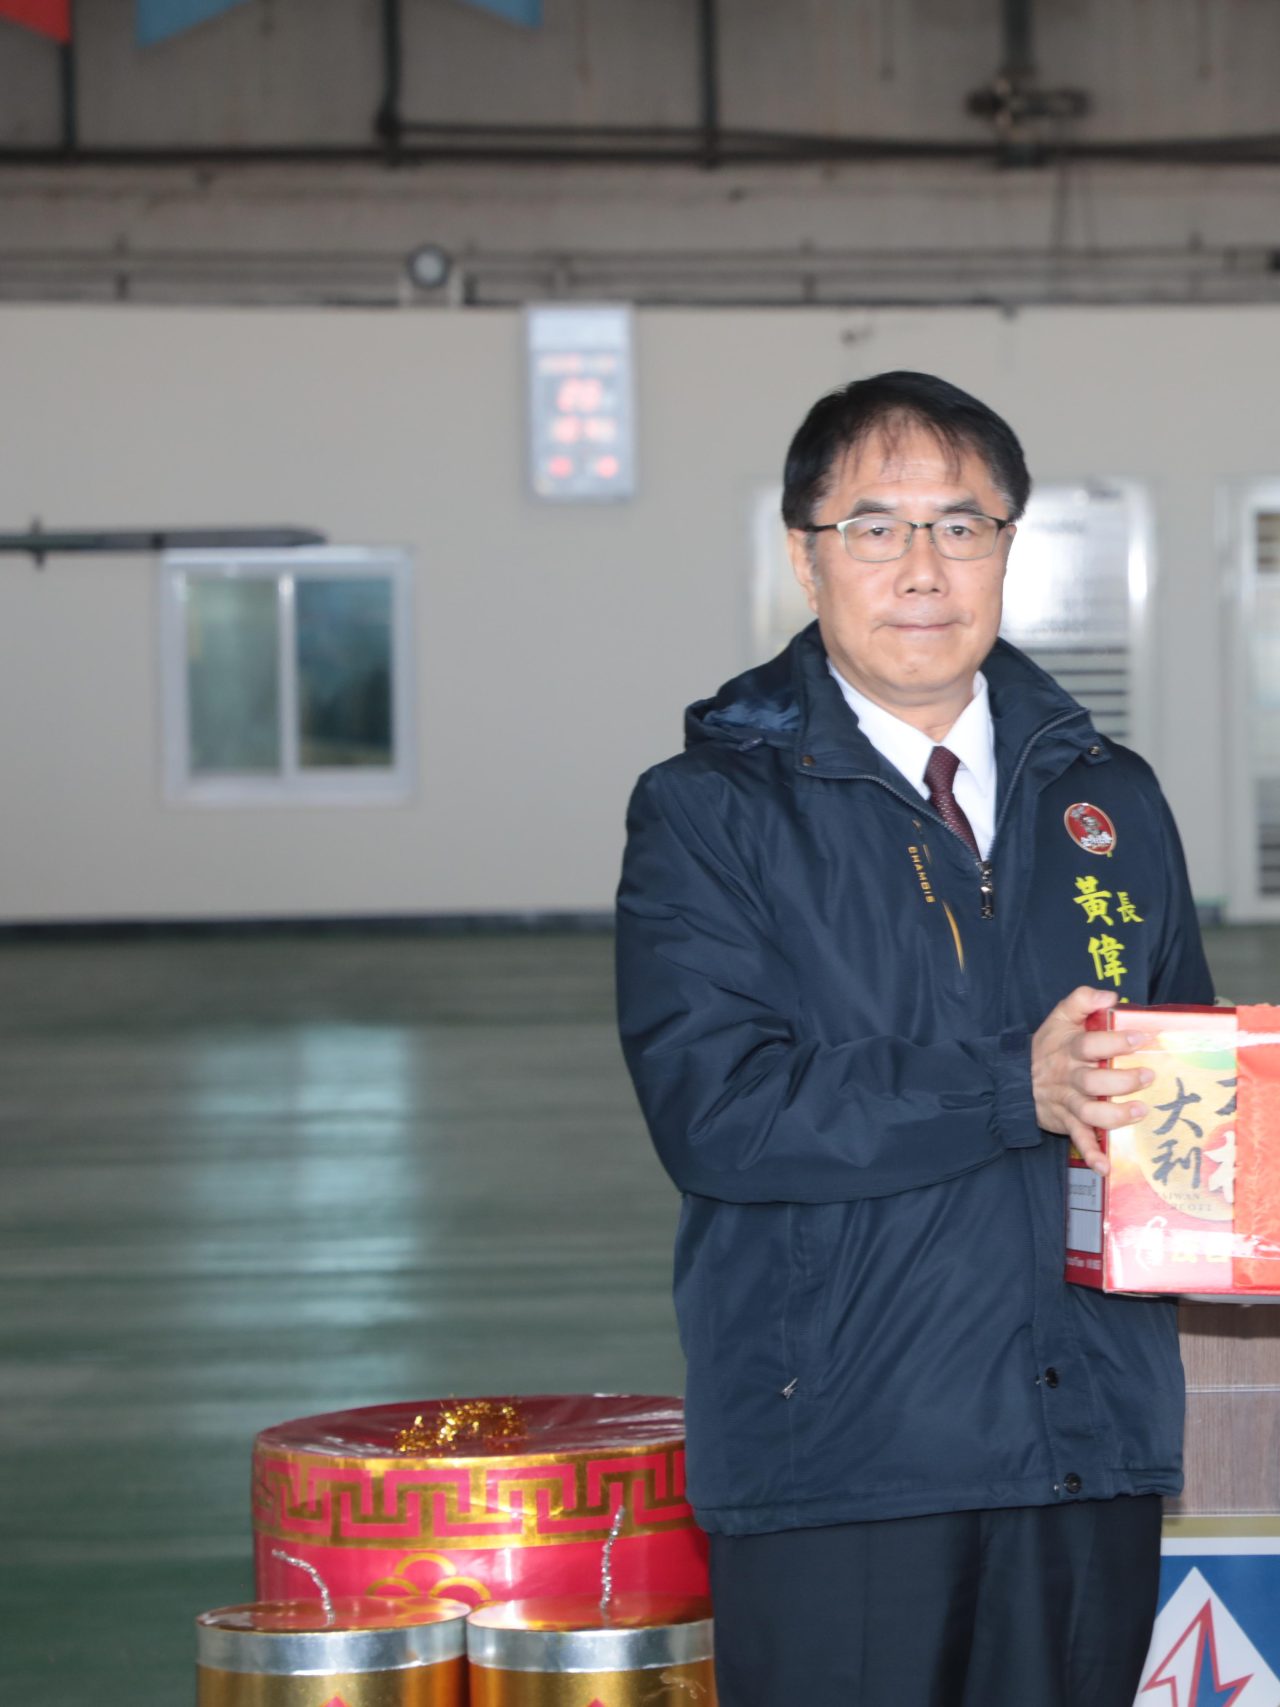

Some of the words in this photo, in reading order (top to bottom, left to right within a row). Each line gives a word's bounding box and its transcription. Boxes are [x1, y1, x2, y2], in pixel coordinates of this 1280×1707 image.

[1073, 875, 1129, 1003] 黃偉
[1116, 891, 1144, 923] 長
[1152, 1077, 1203, 1189] 大利
